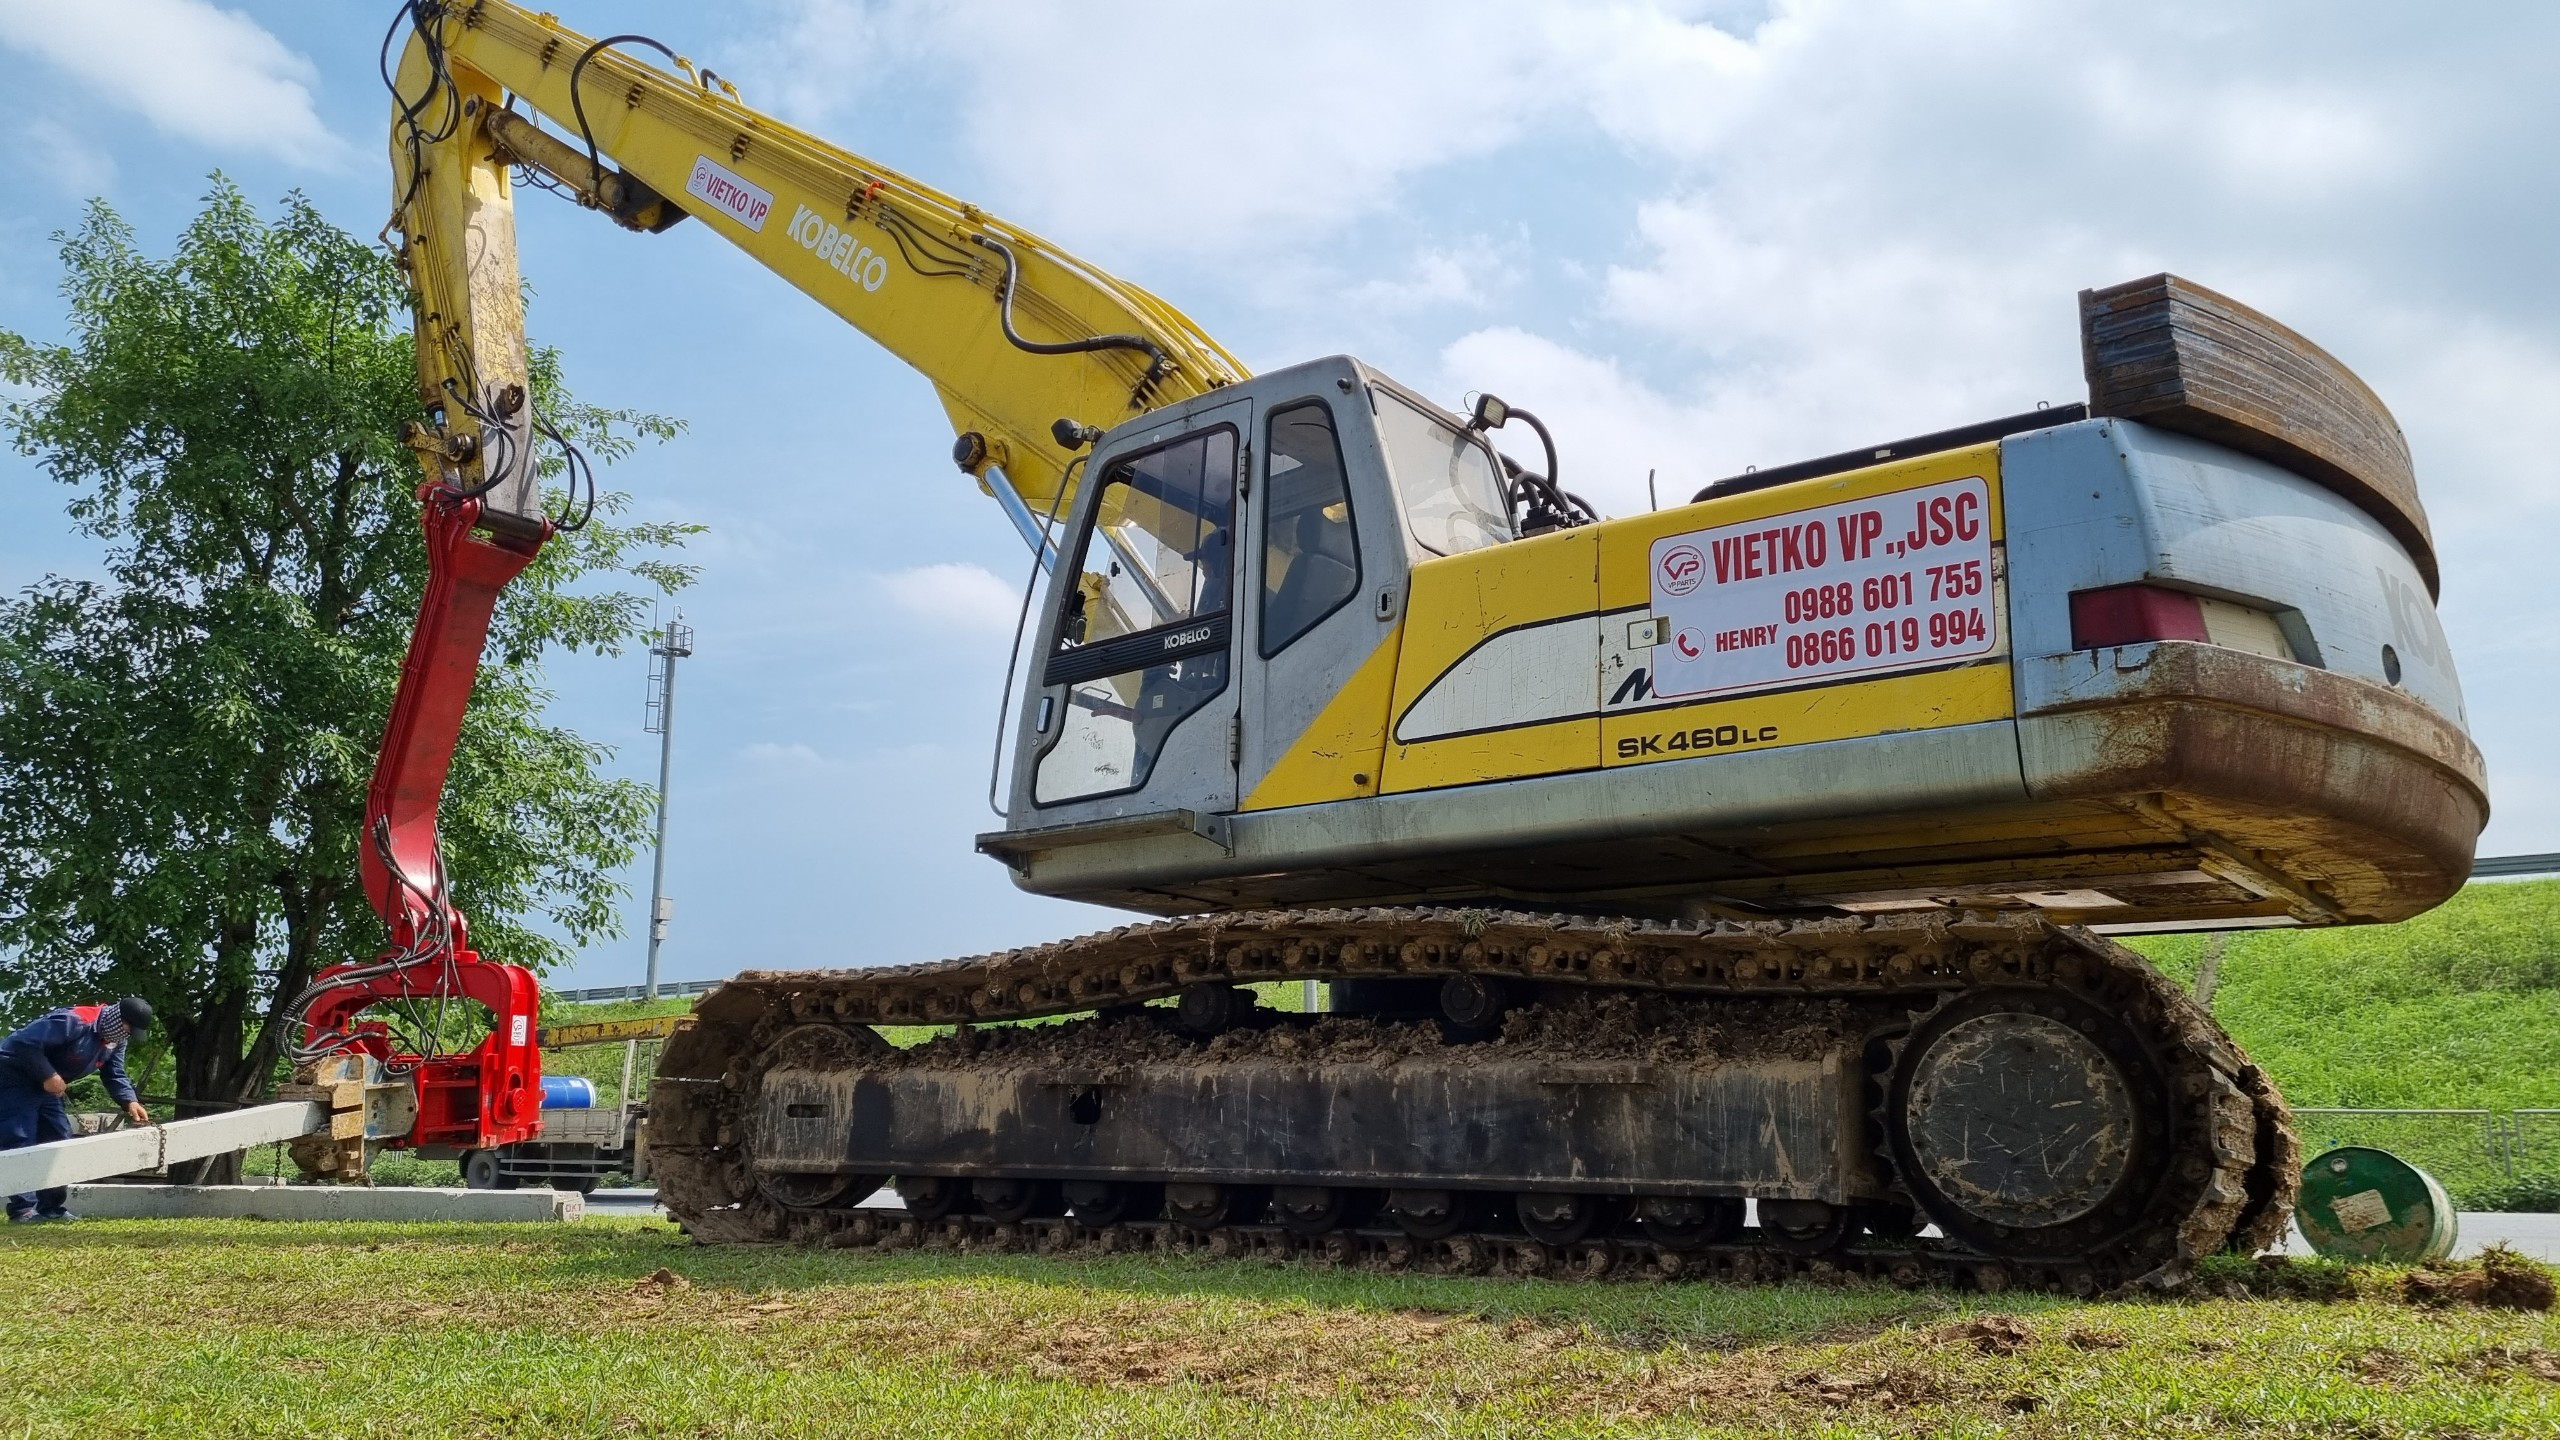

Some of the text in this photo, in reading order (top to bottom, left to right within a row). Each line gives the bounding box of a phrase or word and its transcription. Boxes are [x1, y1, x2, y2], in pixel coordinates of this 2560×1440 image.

[706, 173, 768, 222] VIETKO VP
[786, 203, 887, 292] KOBELCO
[1711, 520, 1827, 585] VIETKO
[1677, 578, 1696, 587] PARTS
[1785, 560, 1982, 624] 0988 601 755
[1164, 626, 1210, 650] KOBELCO
[1716, 623, 1779, 653] HENRY
[1786, 607, 1986, 669] 0866 019 994
